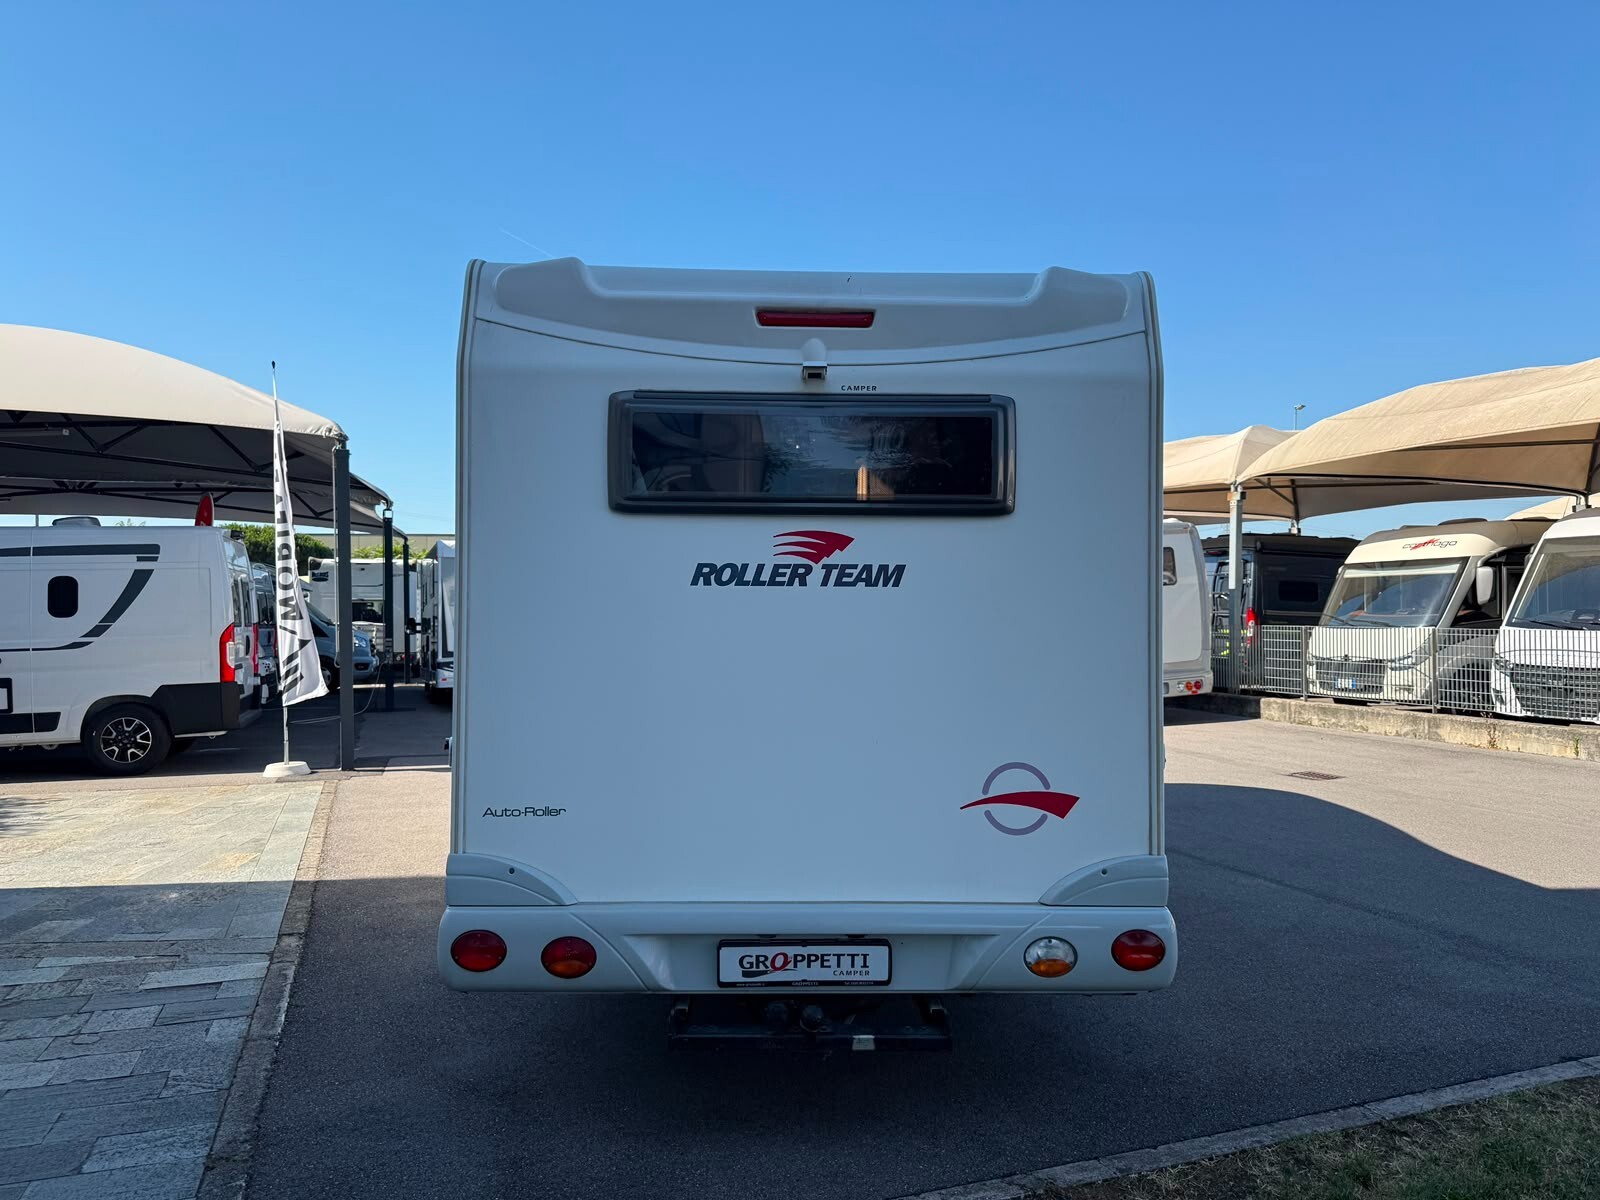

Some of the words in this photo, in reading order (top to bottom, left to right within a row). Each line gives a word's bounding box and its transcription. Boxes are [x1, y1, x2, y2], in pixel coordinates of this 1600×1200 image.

[690, 563, 813, 587] ROLLER
[820, 564, 906, 588] TEAM
[482, 806, 566, 817] Auto-Roller
[738, 952, 870, 971] GROPPETTI
